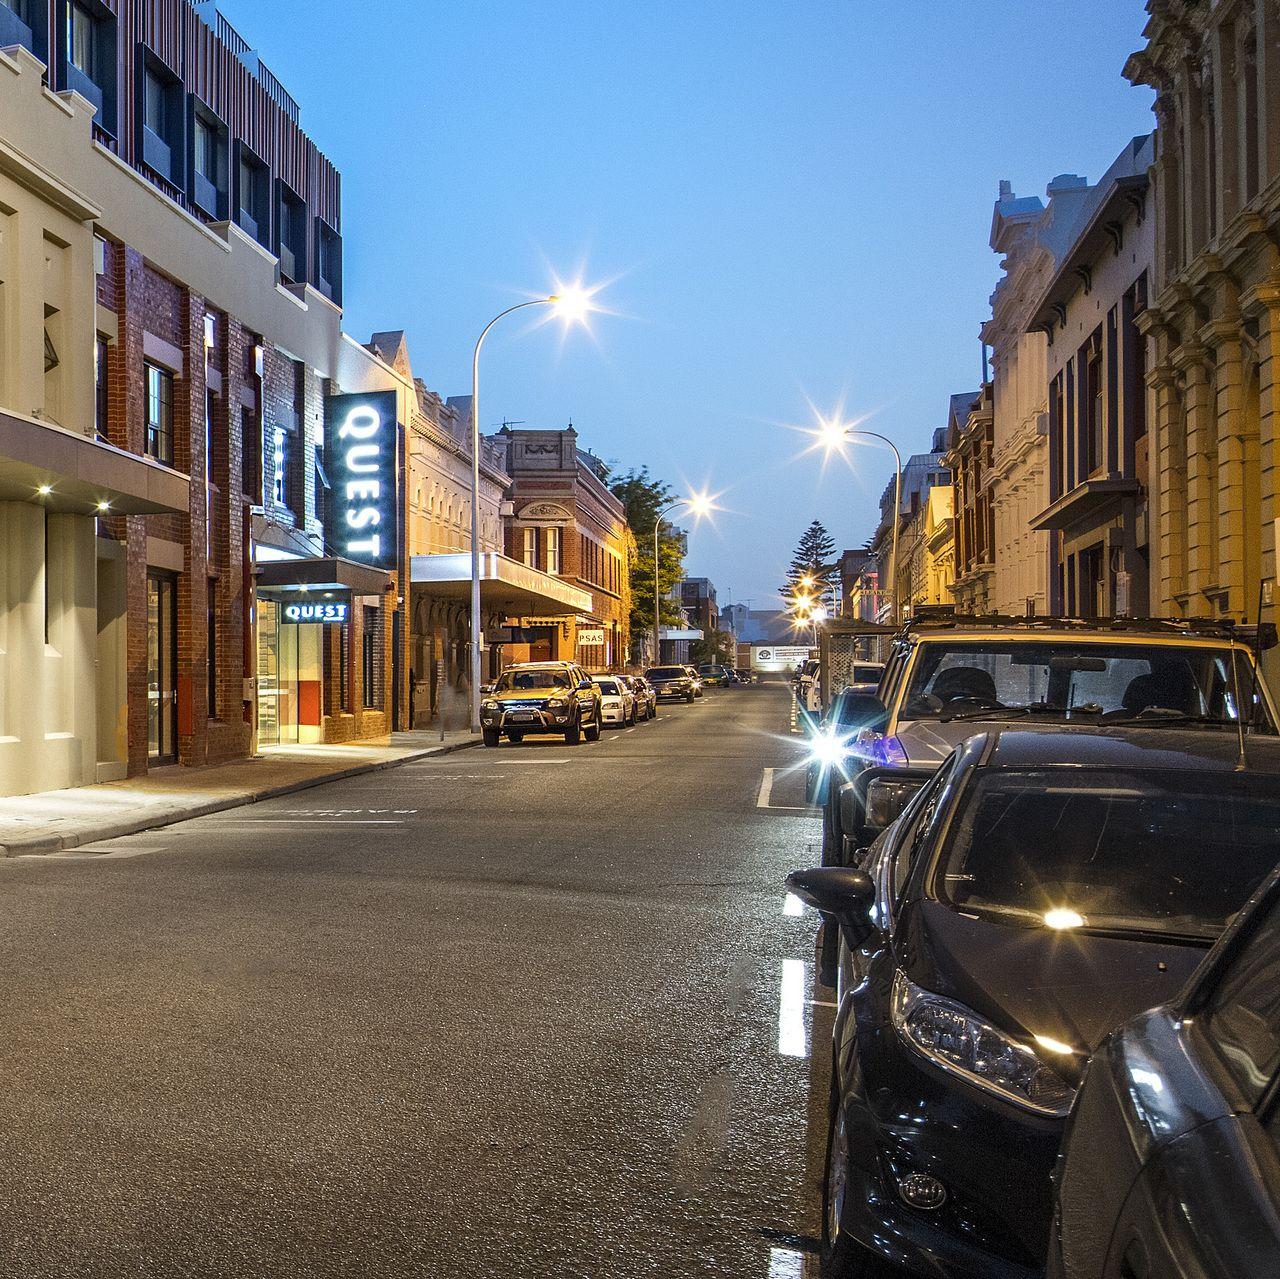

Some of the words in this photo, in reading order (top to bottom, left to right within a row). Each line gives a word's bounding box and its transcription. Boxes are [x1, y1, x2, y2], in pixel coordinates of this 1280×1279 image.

[339, 405, 381, 557] QUEST
[285, 605, 347, 620] QUEST
[579, 634, 603, 642] PSAS
